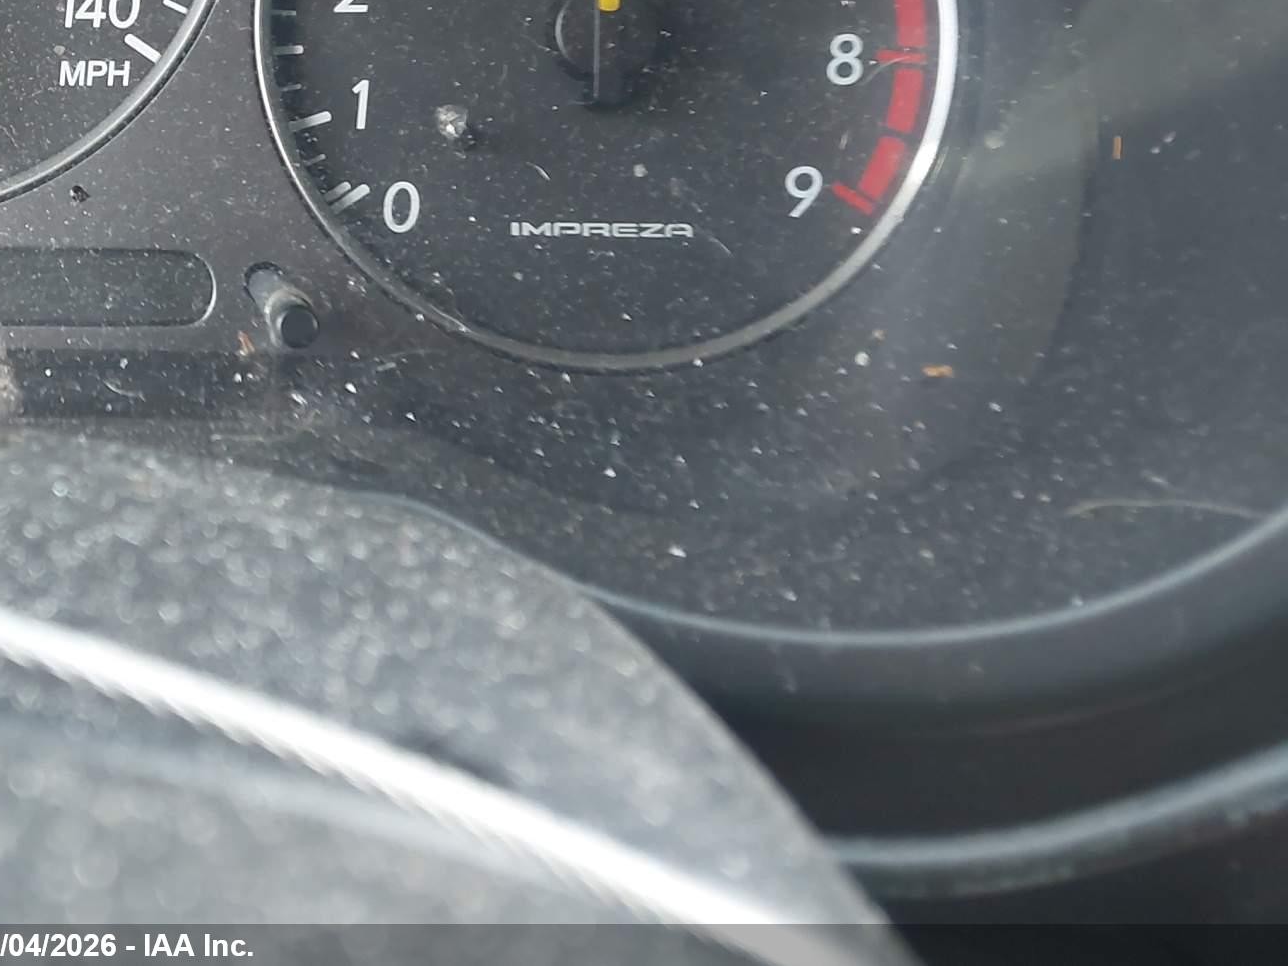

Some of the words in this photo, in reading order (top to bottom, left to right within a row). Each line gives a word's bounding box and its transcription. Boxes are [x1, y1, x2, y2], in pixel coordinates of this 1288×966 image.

[59, 60, 131, 87] MPH
[826, 33, 863, 85] 8
[351, 79, 371, 130] 1
[383, 181, 421, 234] 0
[784, 165, 823, 218] 9
[510, 221, 695, 238] IMPREZA
